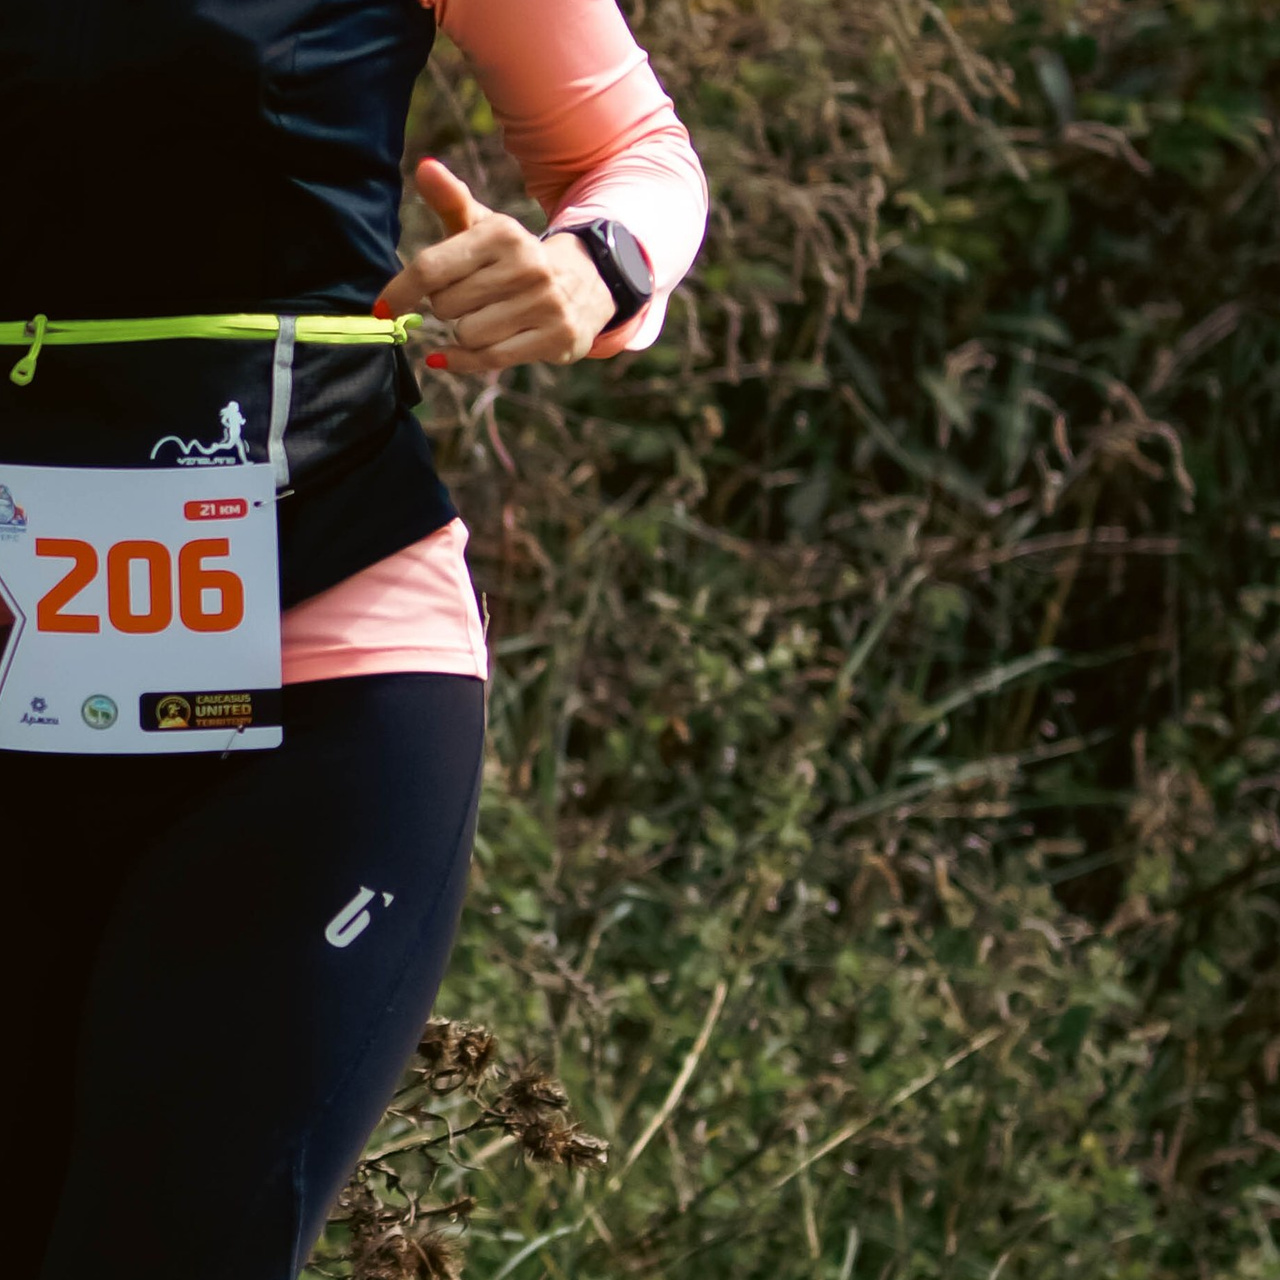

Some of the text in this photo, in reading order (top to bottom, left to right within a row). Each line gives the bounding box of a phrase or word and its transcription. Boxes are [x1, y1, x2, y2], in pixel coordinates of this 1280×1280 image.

[199, 503, 216, 517] 21
[35, 537, 245, 634] 206
[195, 694, 251, 704] CAUCASUS
[195, 704, 252, 717] UNITED
